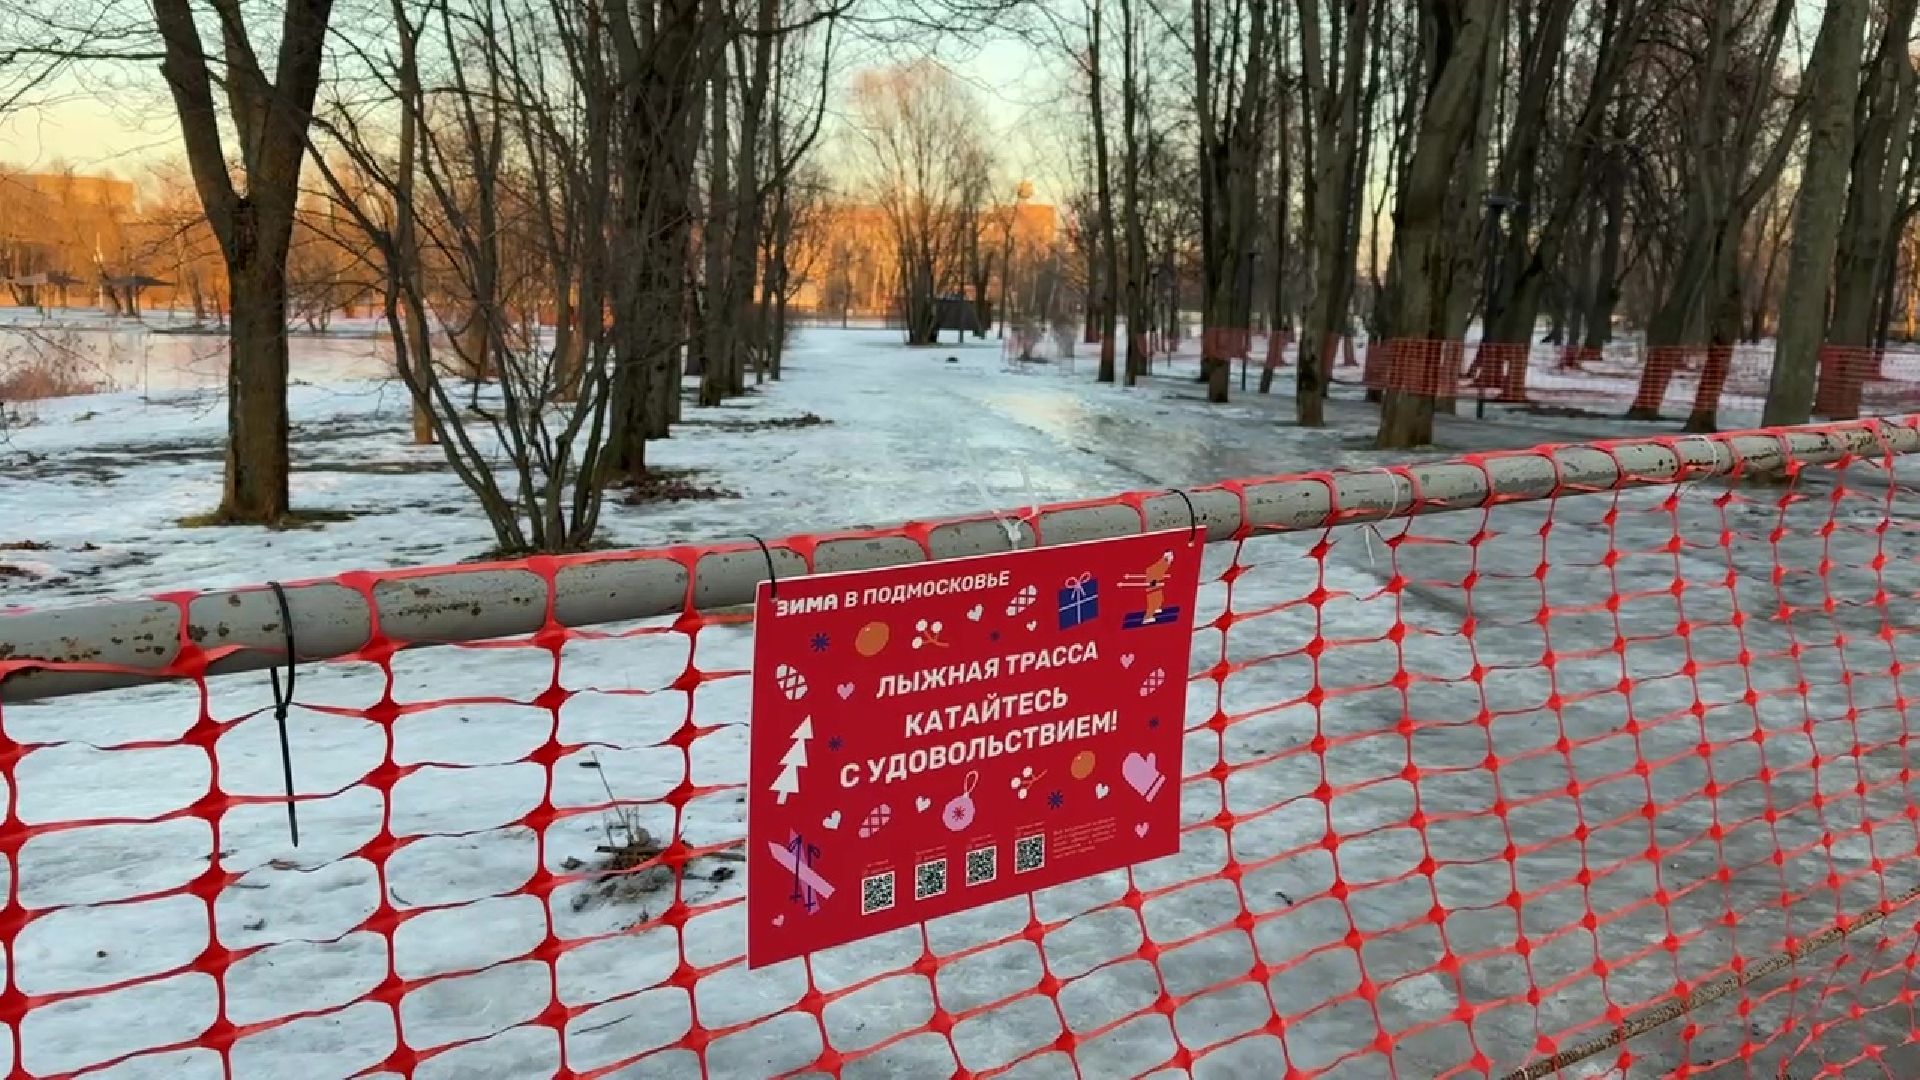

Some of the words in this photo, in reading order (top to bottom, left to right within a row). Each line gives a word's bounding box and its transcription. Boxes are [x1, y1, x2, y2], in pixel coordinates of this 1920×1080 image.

[776, 593, 838, 617] ЗИМА
[844, 591, 859, 608] В
[863, 571, 1010, 605] ПОДМОСКОВЬЕ
[876, 657, 1000, 699] ЛЫЖНАЯ
[1005, 641, 1099, 676] ТРАССА
[905, 686, 1069, 739] КАТАЙТЕСЬ
[840, 763, 860, 788] С
[867, 710, 1118, 784] УДОВОЛЬСТВИЕМ!
